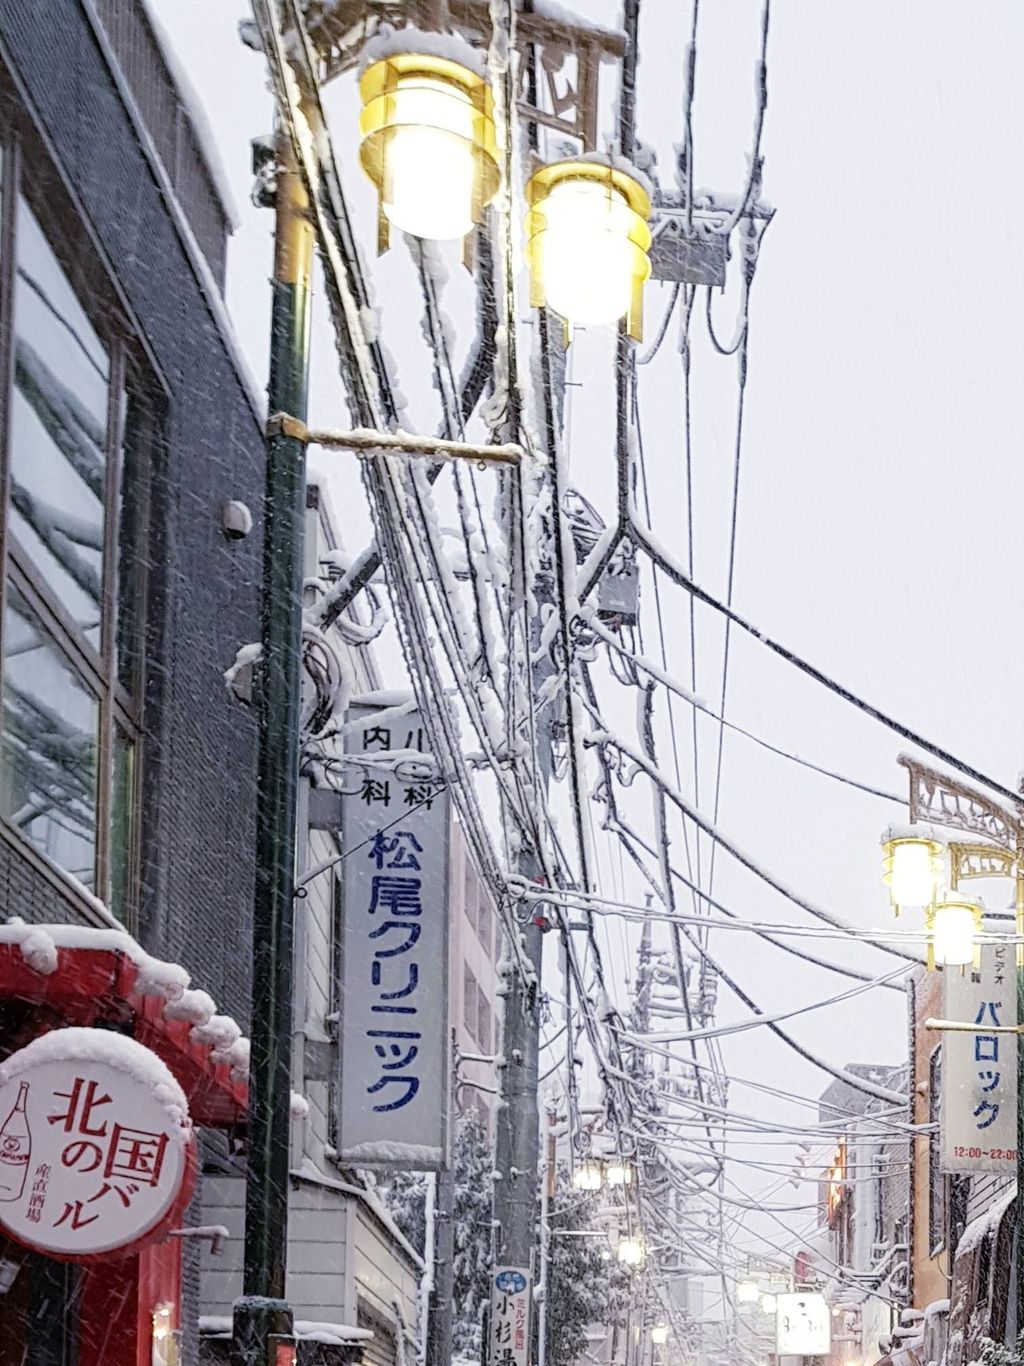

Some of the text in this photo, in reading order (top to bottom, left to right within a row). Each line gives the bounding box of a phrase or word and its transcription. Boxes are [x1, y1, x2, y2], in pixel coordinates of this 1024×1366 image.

[403, 728, 434, 810] 小科
[367, 830, 424, 1113] 松尾クリニック
[973, 1001, 1002, 1130] バロック
